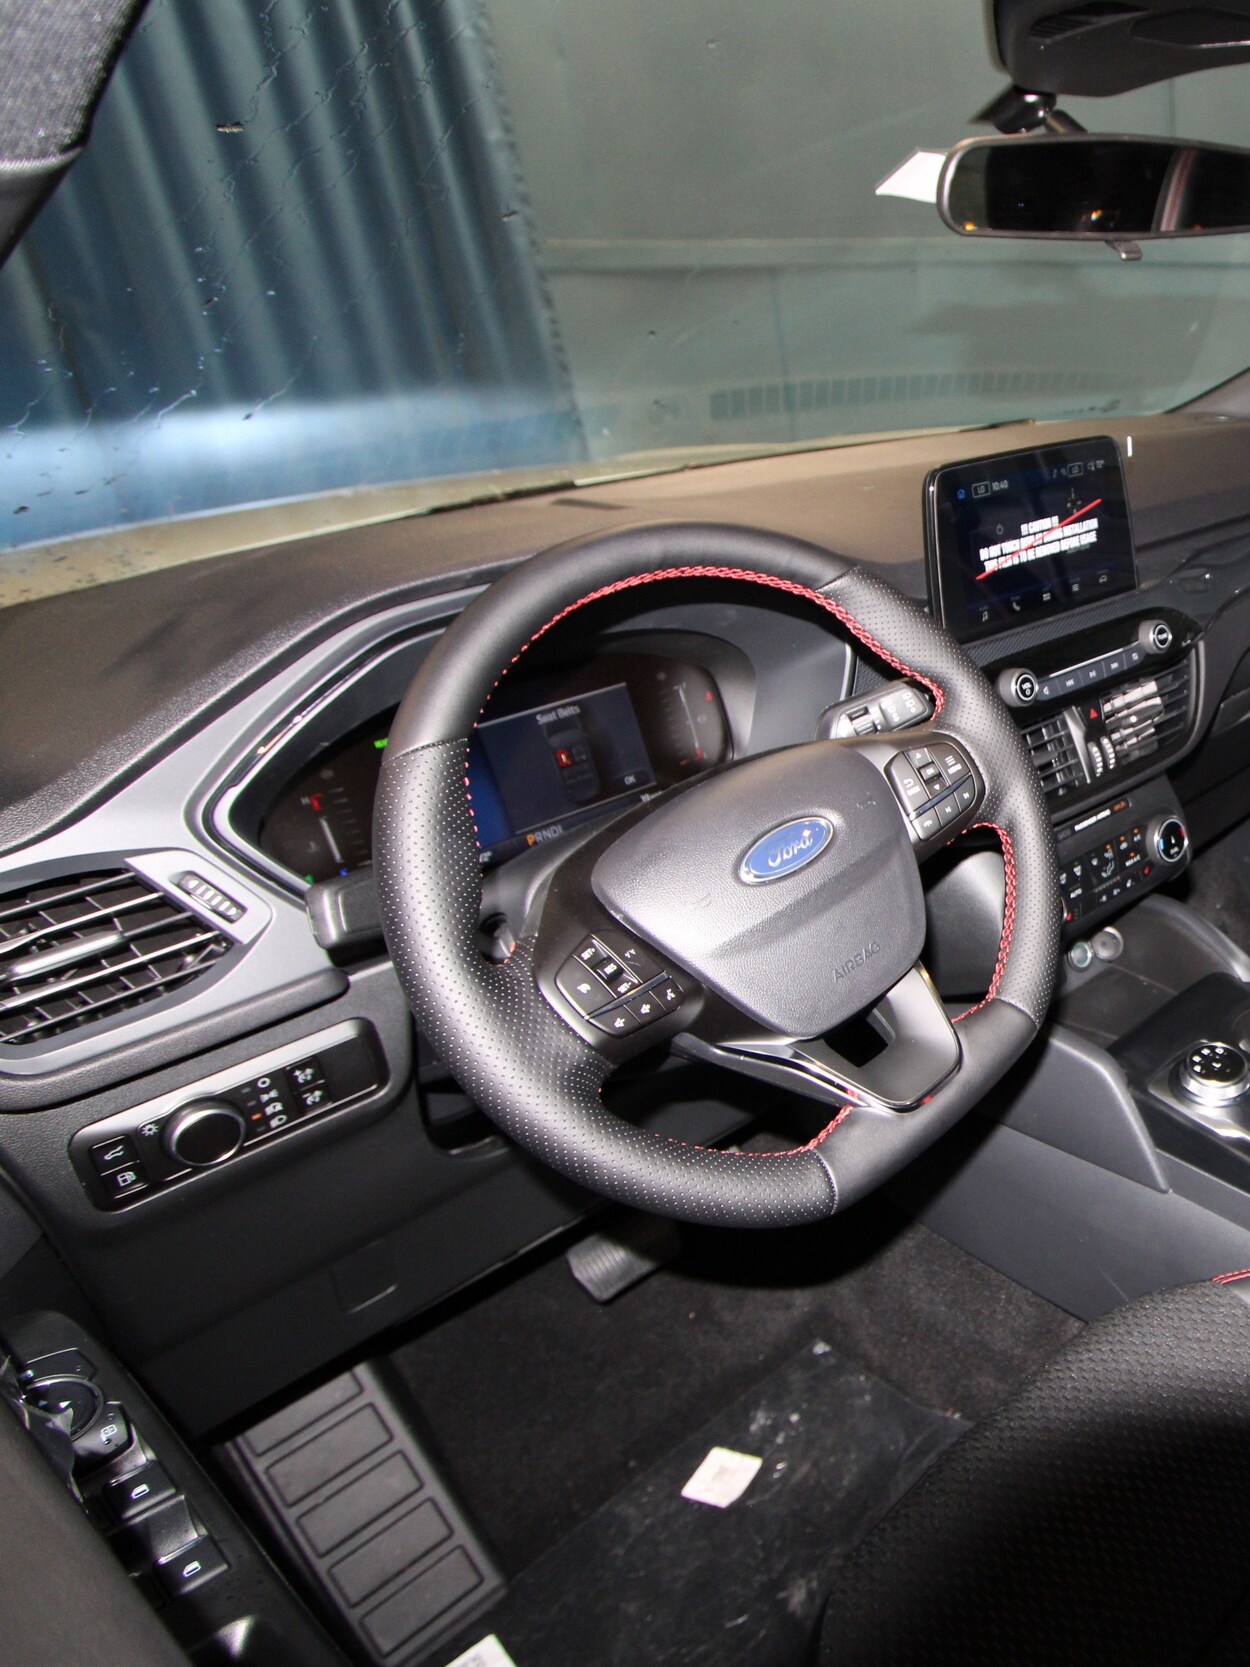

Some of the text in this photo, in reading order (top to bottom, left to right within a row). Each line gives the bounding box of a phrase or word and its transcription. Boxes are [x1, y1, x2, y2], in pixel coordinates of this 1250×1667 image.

[536, 704, 581, 725] Seat Belts
[624, 774, 636, 785] OK
[764, 829, 814, 868] Ford
[833, 941, 880, 983] AIRBAG
